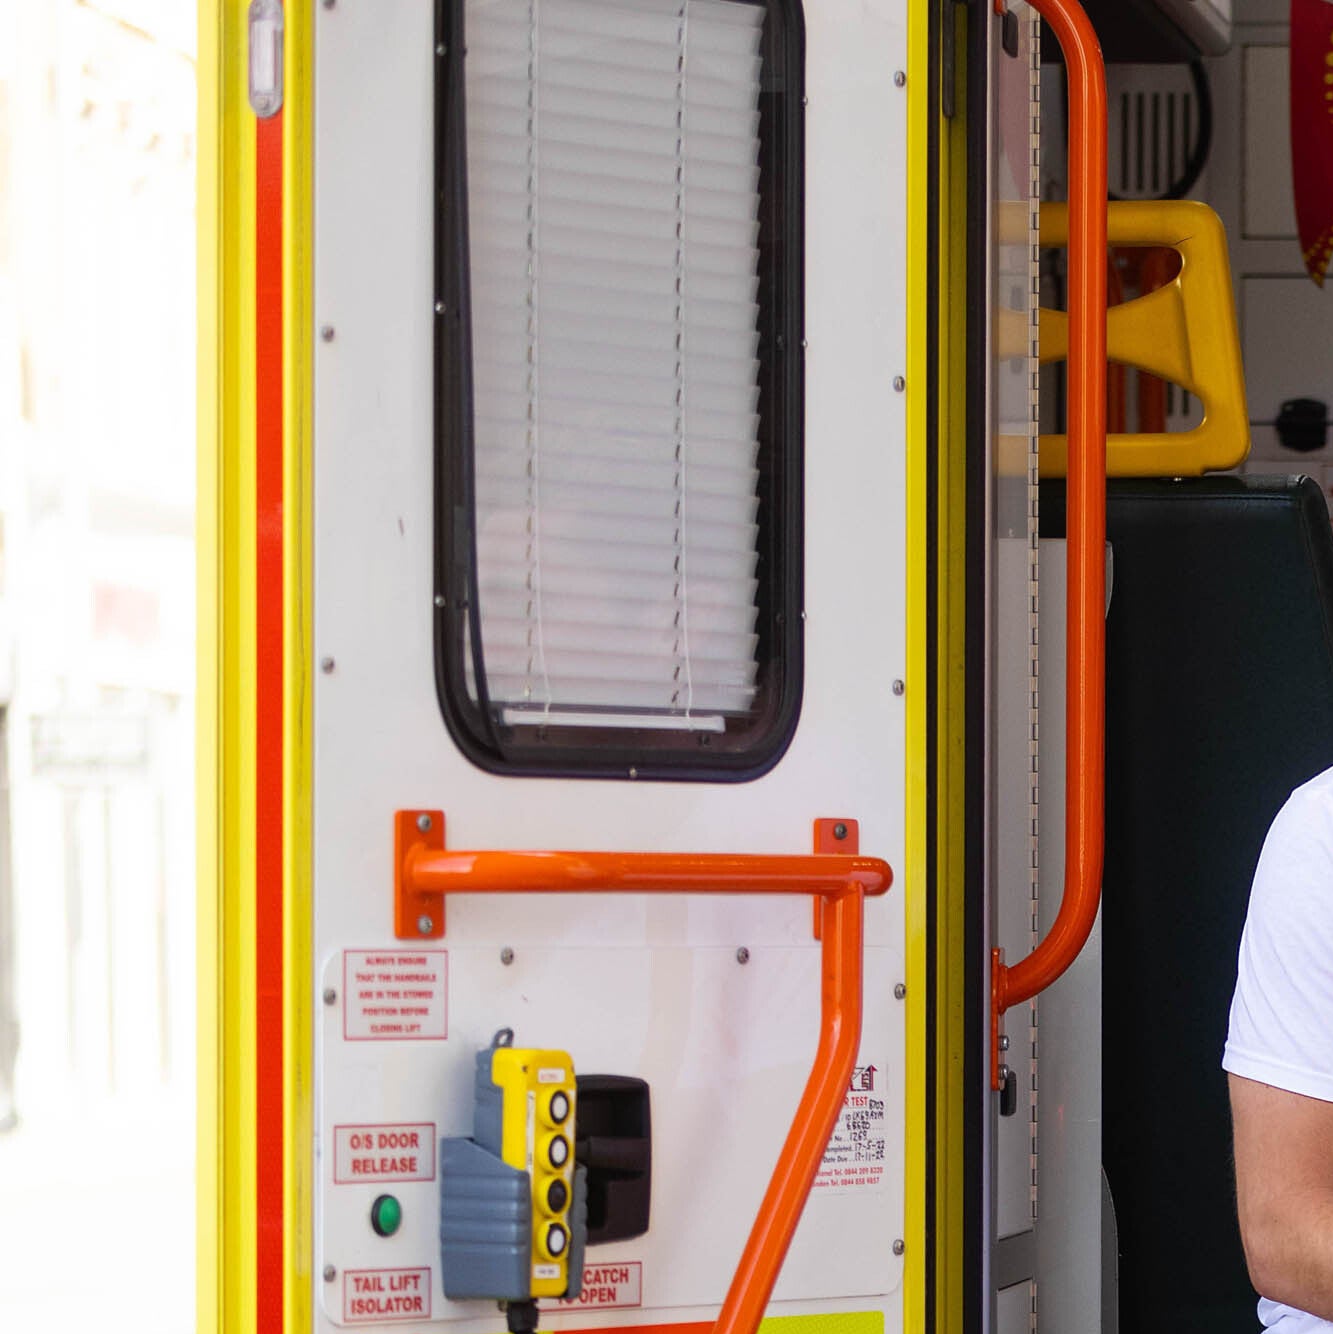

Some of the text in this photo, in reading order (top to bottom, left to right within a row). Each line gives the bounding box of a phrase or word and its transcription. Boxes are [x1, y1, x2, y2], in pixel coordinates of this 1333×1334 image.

[851, 1096, 868, 1106] TEST
[350, 1132, 419, 1150] O/S DOOR
[352, 1156, 417, 1174] RELEASE
[353, 1274, 421, 1293] TAIL LIFT
[583, 1268, 629, 1285] CATCH
[578, 1287, 617, 1304] OPEN
[351, 1296, 423, 1315] ISOLATOR
